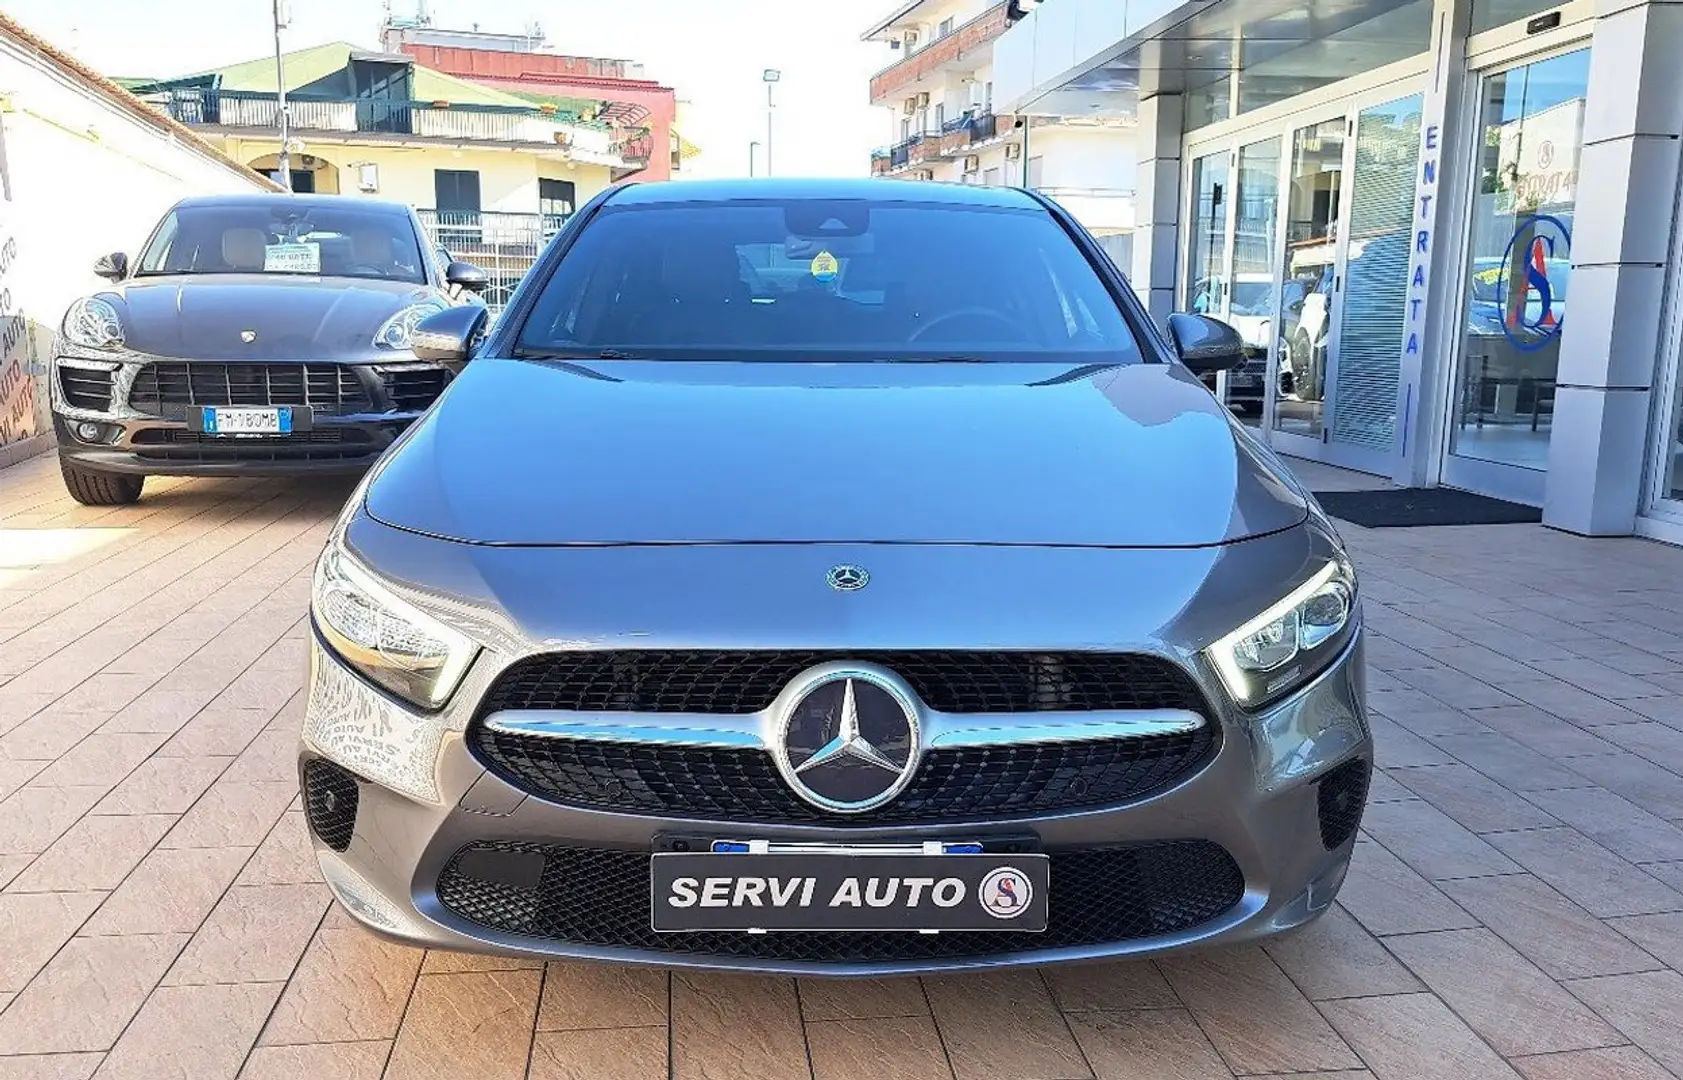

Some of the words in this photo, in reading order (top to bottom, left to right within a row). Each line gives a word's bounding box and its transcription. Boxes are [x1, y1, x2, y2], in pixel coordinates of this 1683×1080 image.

[1405, 126, 1438, 354] ENTRATA
[668, 877, 817, 907] SERVI
[828, 877, 967, 907] AUTO
